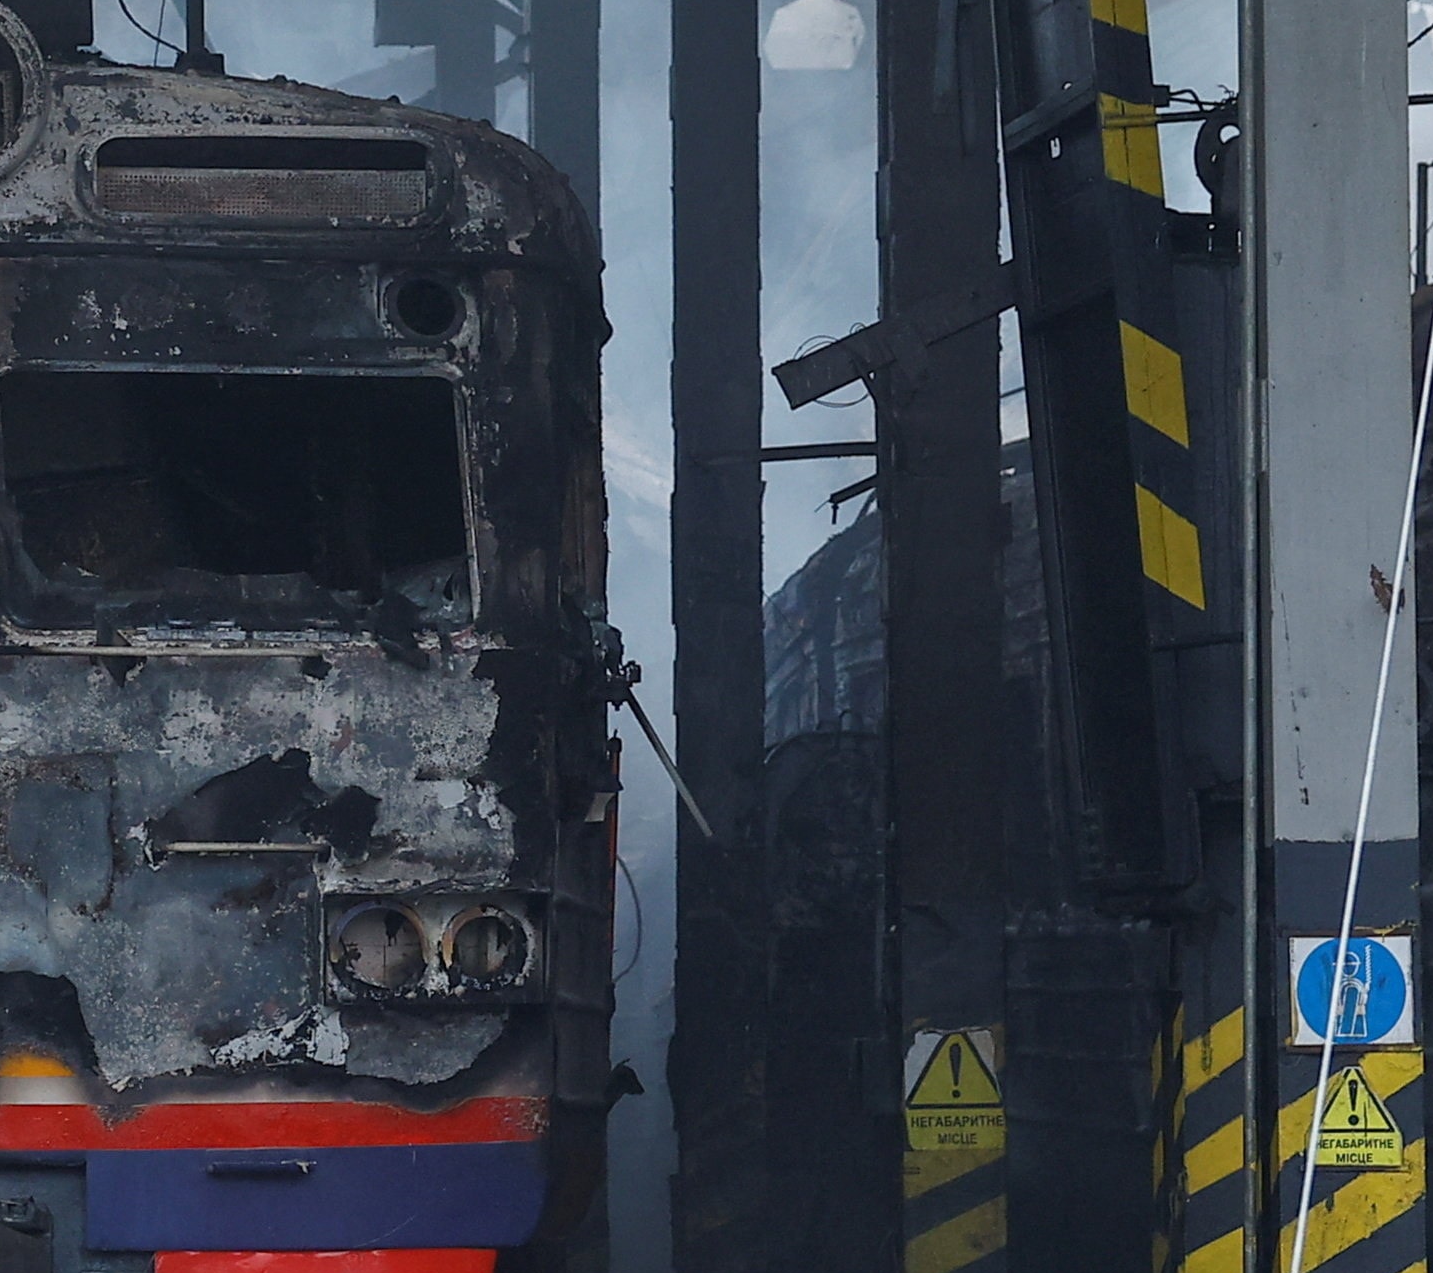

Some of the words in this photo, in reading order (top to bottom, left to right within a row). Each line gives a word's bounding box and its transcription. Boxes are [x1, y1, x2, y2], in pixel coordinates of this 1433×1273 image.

[910, 1115, 1005, 1128] НЕГАБАРИТНЕ
[937, 1133, 978, 1145] МІСЦЕ
[1316, 1138, 1394, 1150] НЕГАБАРИТНЕ
[1335, 1153, 1374, 1165] МІСЦЕ
